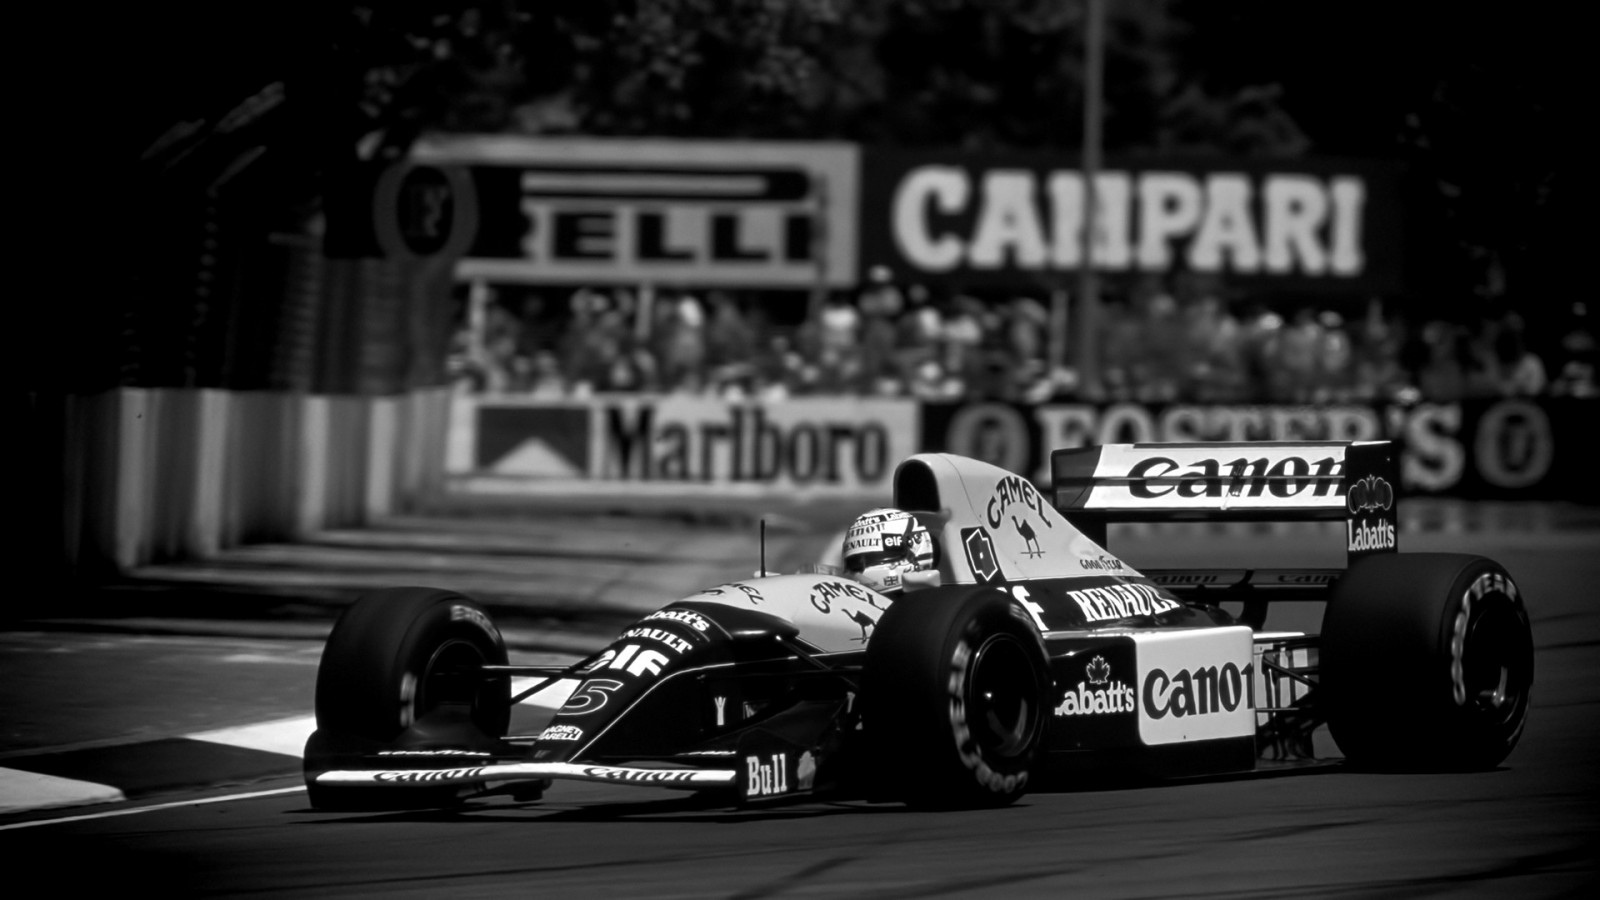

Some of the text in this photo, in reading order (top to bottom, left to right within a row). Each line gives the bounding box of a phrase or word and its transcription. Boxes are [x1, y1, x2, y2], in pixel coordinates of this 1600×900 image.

[892, 164, 1366, 276] CAMPARI
[607, 398, 890, 484] Marlboro
[987, 475, 1052, 530] CAMEL
[884, 536, 902, 547] elf
[1347, 518, 1395, 551] Labatt's
[1152, 574, 1218, 584] anon
[1277, 574, 1334, 584] Can
[810, 581, 889, 614] CAMEL
[618, 628, 693, 654] NAULT
[556, 678, 624, 715] 5
[746, 753, 788, 796] Bull
